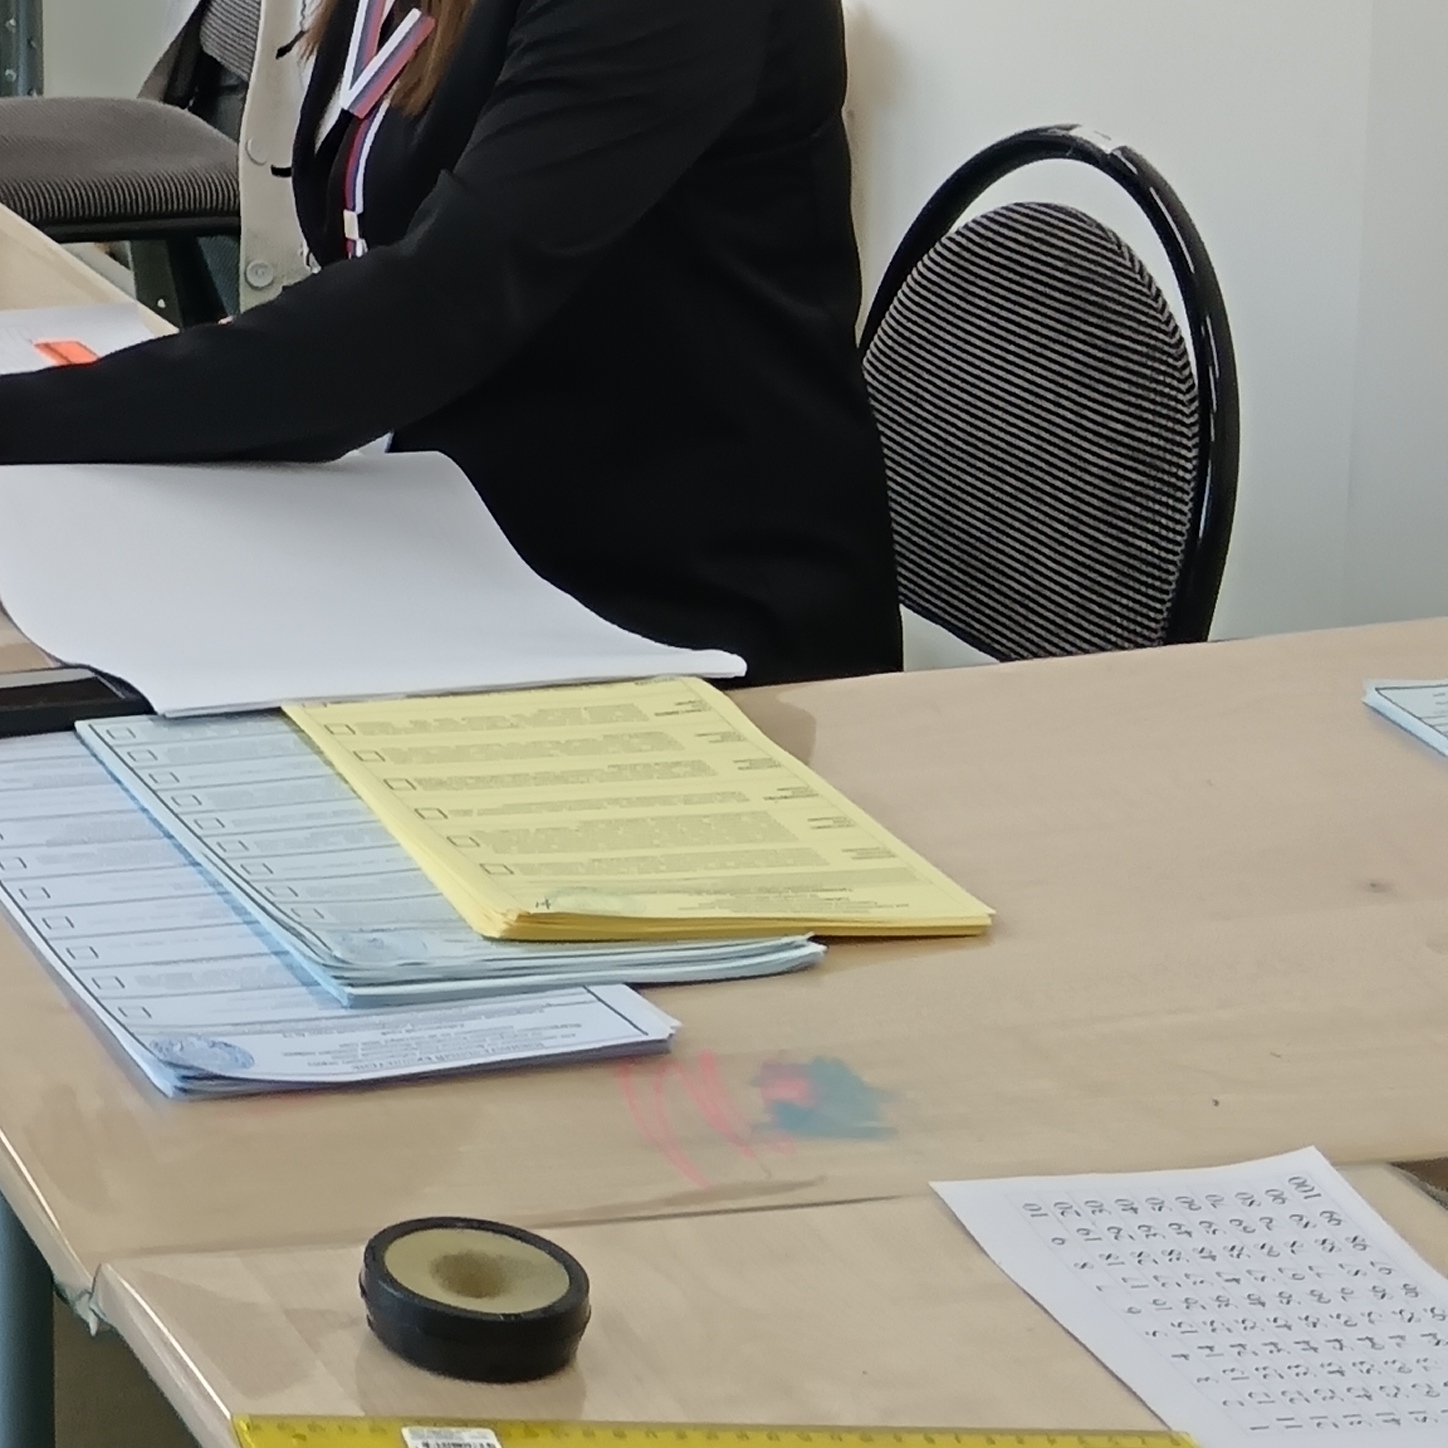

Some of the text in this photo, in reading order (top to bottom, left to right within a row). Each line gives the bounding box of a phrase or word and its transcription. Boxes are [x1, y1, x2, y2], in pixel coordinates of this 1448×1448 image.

[1287, 1175, 1321, 1199] 100
[1022, 1202, 1048, 1218] 10
[1114, 1198, 1138, 1214] 40
[1051, 1236, 1066, 1246] 9
[1196, 1344, 1224, 1357] 14
[1292, 1339, 1318, 1353] 44
[1170, 1353, 1190, 1362] 4
[1275, 1416, 1303, 1429] 11
[1374, 1411, 1401, 1426] 41
[1248, 1424, 1269, 1432] 1
